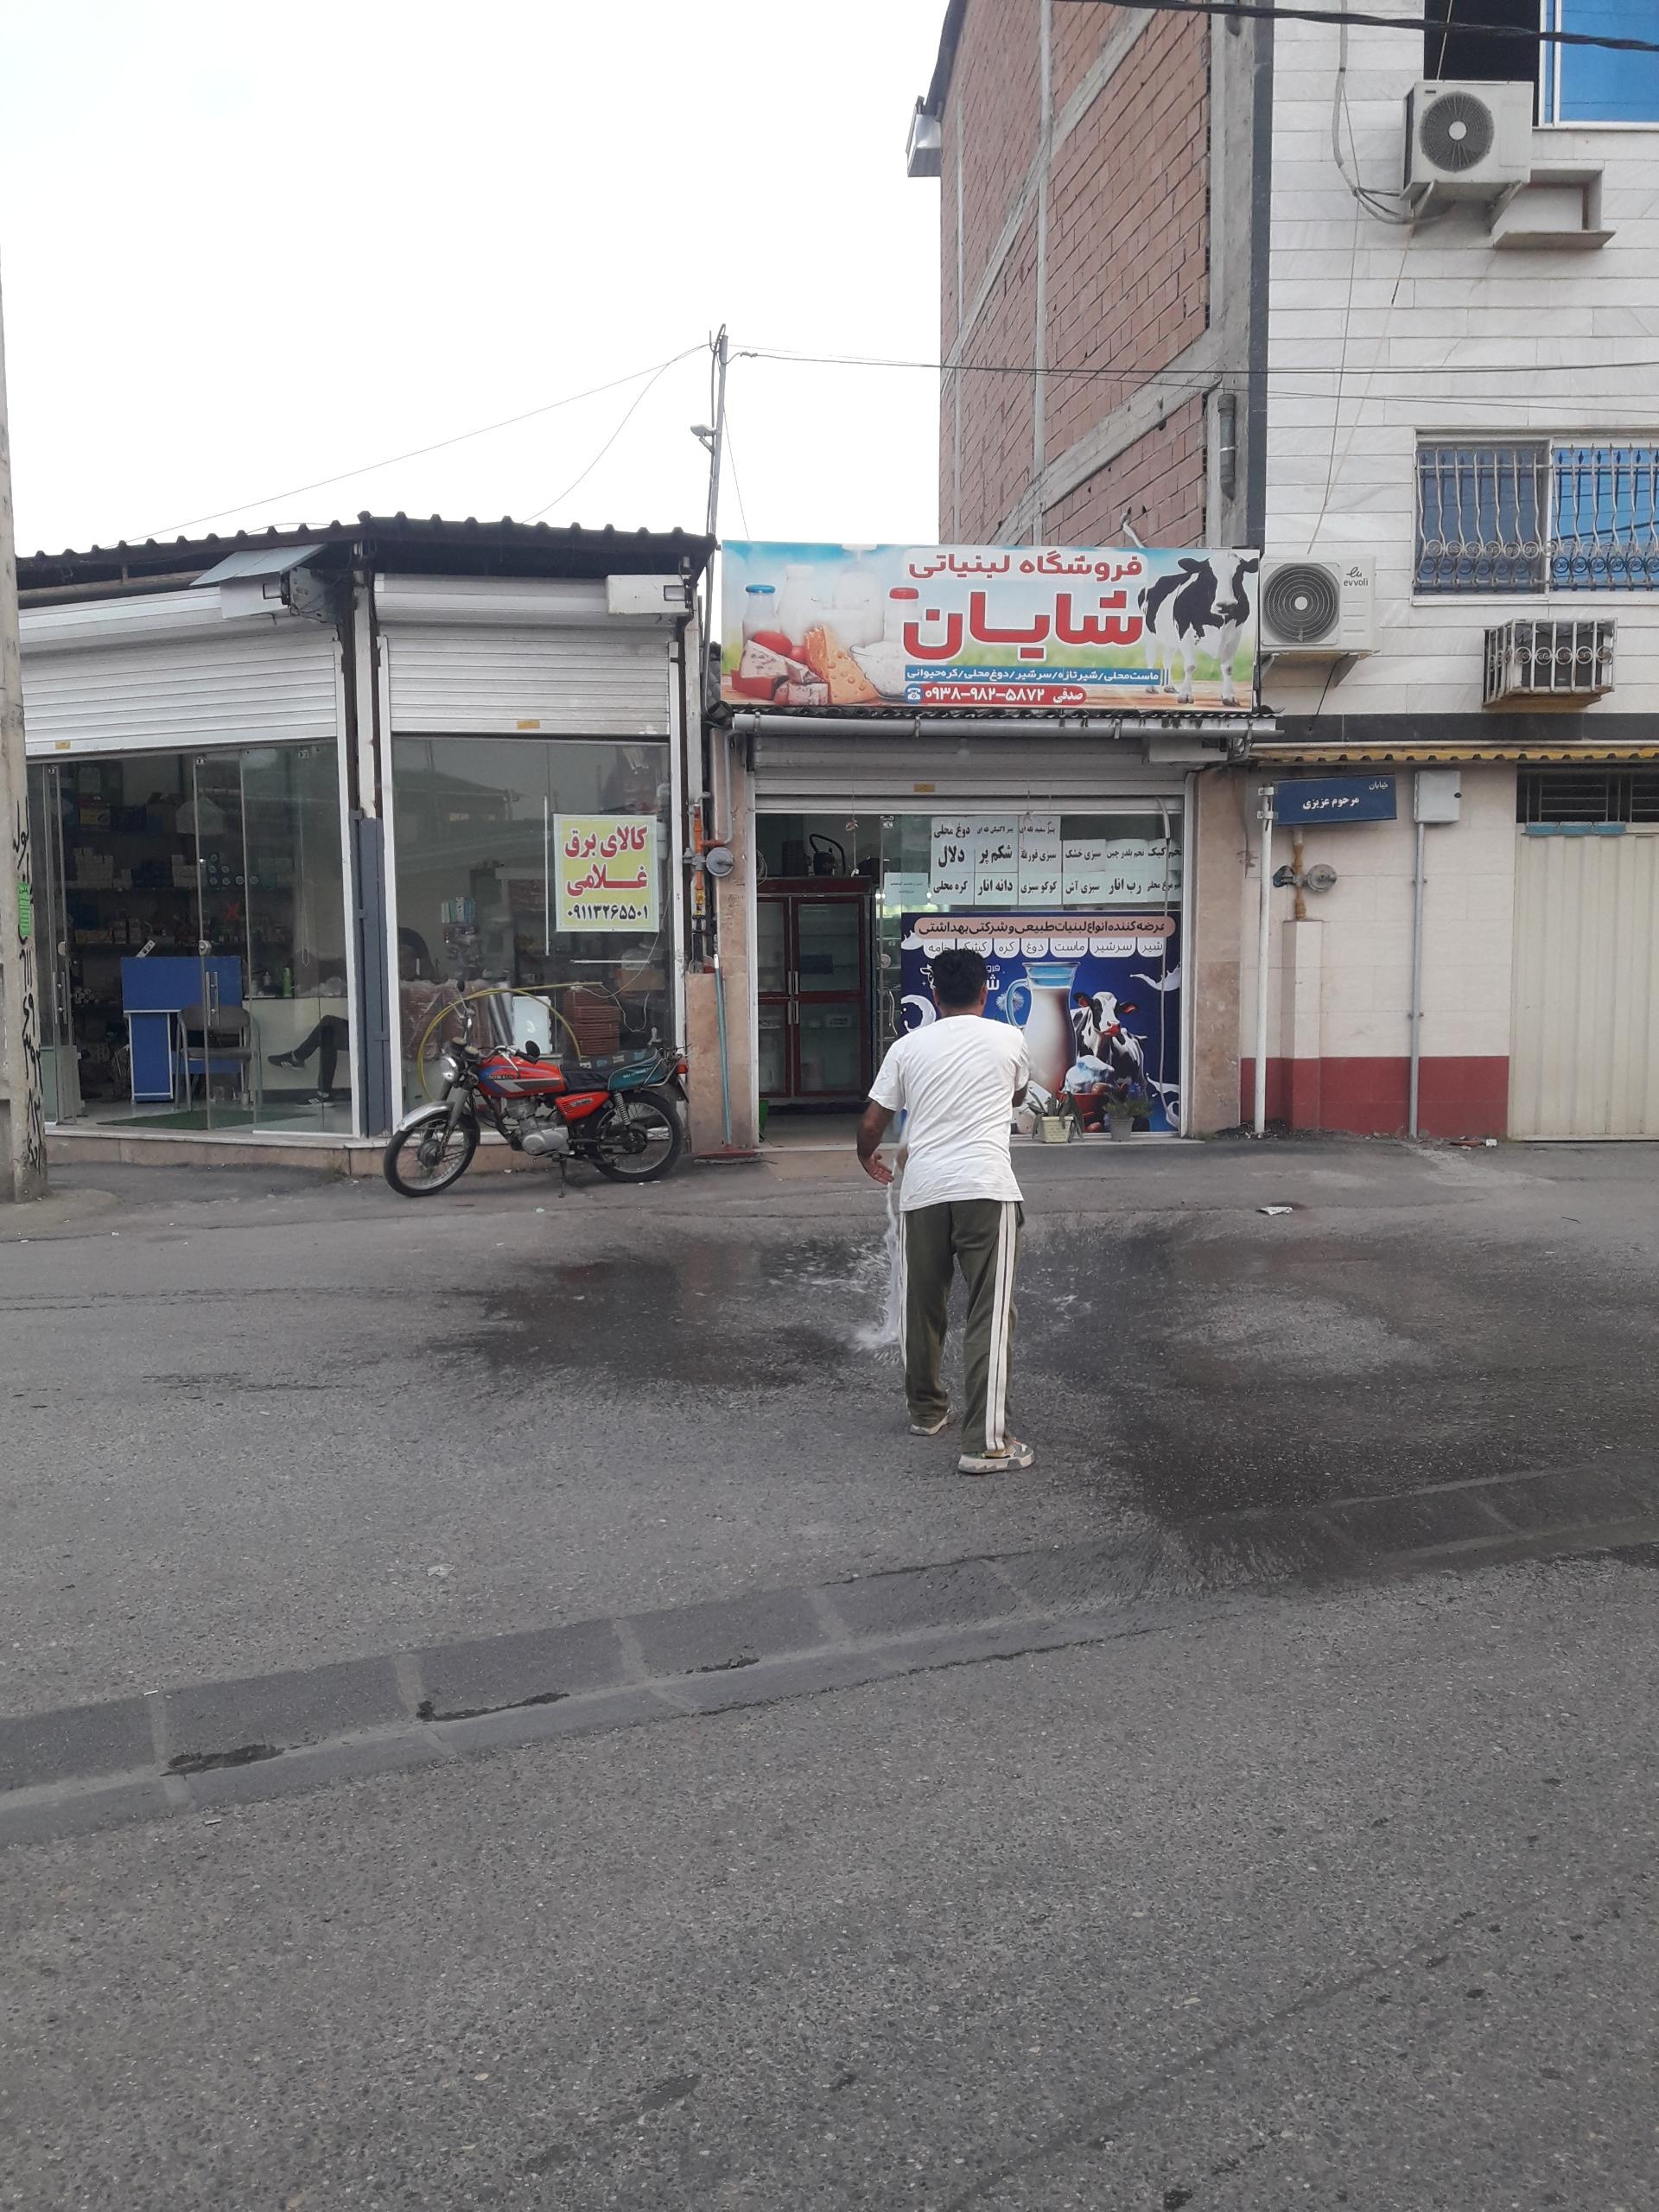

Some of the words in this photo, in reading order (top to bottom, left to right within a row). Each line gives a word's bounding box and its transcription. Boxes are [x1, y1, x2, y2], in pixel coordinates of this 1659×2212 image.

[909, 553, 1010, 578] لبنیاتی
[1020, 550, 1142, 582] فروشگاه
[903, 590, 1143, 659] شایان
[1053, 688, 1083, 703] صدقی
[1369, 780, 1389, 790] خیابان
[1303, 798, 1330, 810] عزیزی
[1332, 797, 1360, 808] مرحوم
[934, 824, 953, 838] محلی
[956, 823, 970, 838] دوغ
[565, 830, 596, 858] برق
[601, 826, 647, 857] کالای
[938, 845, 964, 868] دلال
[979, 849, 988, 864] پر
[991, 844, 1012, 863] شکم
[1039, 851, 1056, 861] سبزی
[1065, 848, 1083, 858] خشک
[1084, 851, 1101, 861] سبزی
[567, 864, 647, 896] غلامی
[933, 880, 953, 893] محلی
[955, 880, 968, 893] کره
[995, 879, 1013, 891] دانه
[1040, 880, 1057, 893] کوکو
[1109, 878, 1123, 894] انار
[978, 879, 993, 895] انار
[1020, 883, 1039, 893] سبزی
[1065, 880, 1078, 894] آش
[1081, 882, 1100, 893] سبزی
[1127, 881, 1141, 894] رب
[568, 905, 648, 919] ۰۹۱۱۳۲۶۵۵۰۱
[918, 921, 969, 934] بهداشتی
[1015, 921, 1054, 934] طبیعی
[1055, 921, 1086, 933] لبنیات
[999, 941, 1014, 954] کره
[1027, 942, 1044, 954] دوغ
[1054, 941, 1084, 950] ماست
[1142, 941, 1163, 953] شیر
